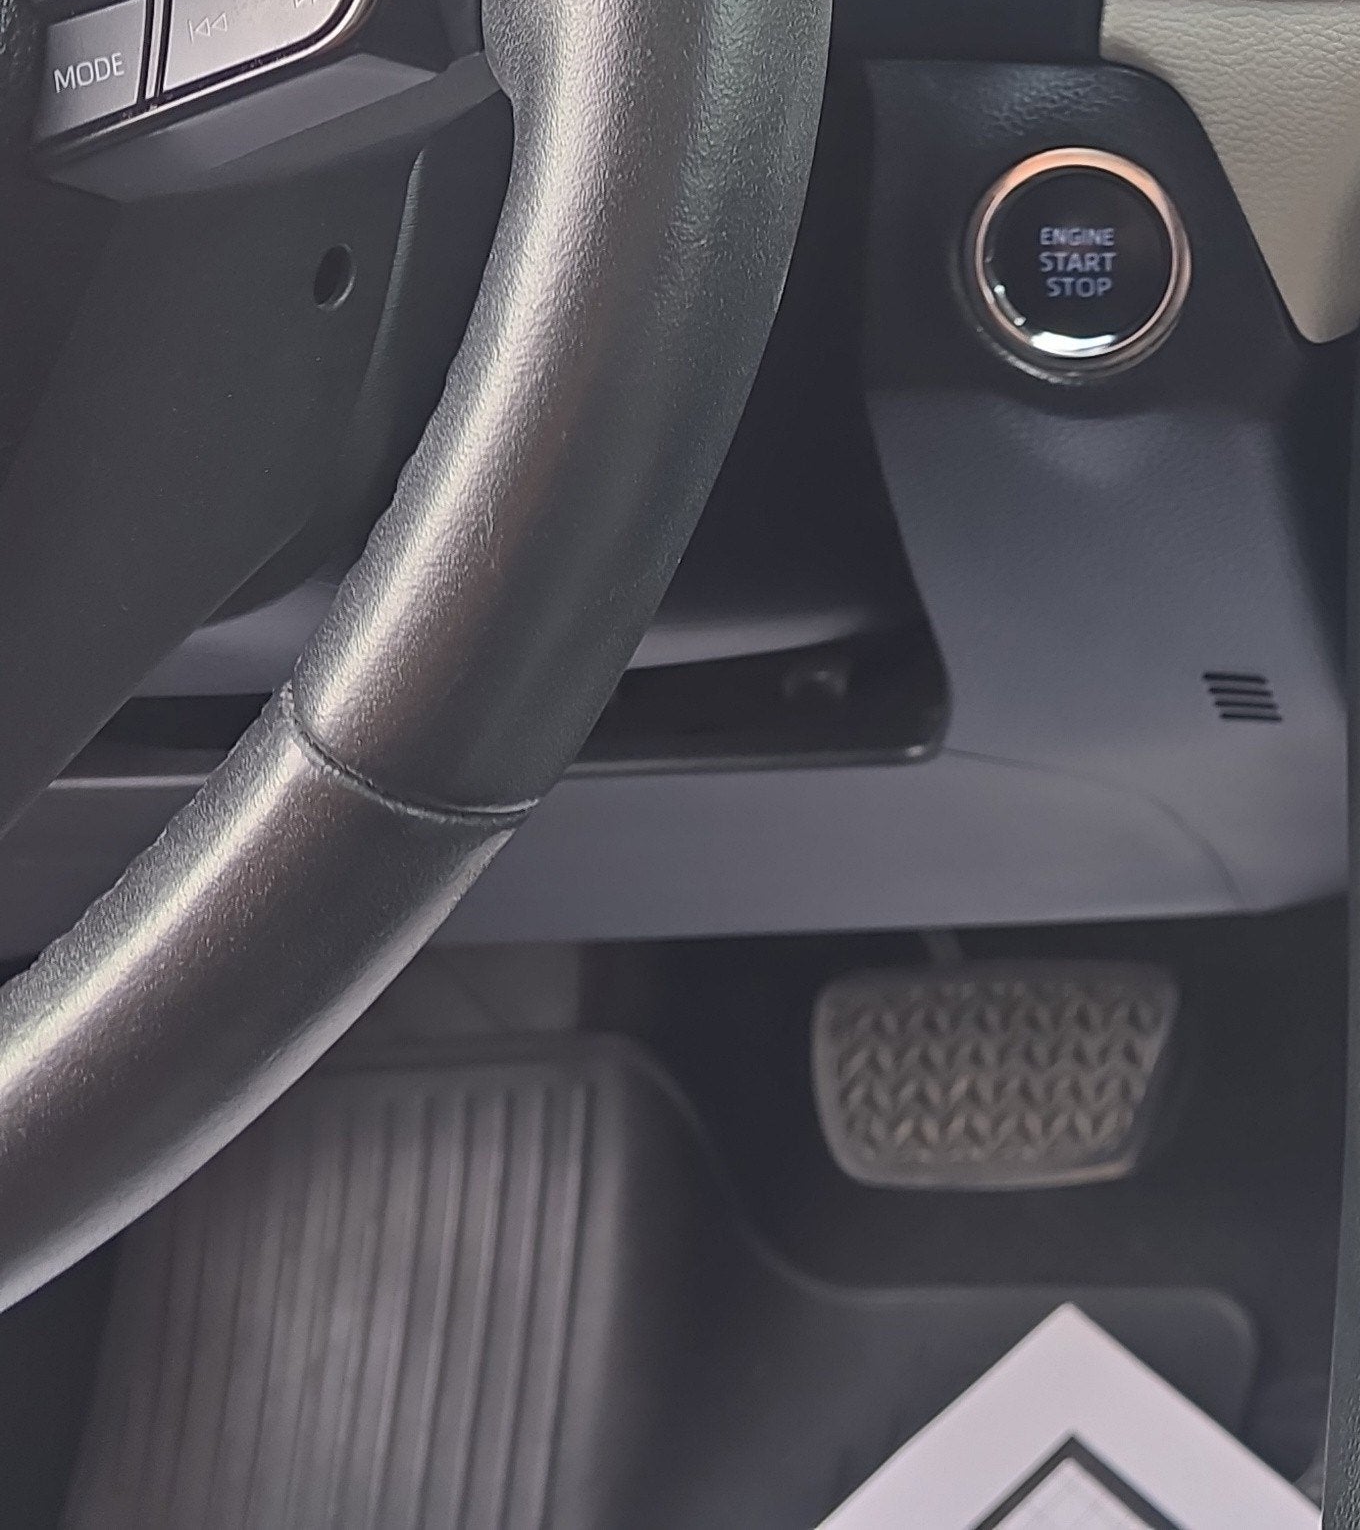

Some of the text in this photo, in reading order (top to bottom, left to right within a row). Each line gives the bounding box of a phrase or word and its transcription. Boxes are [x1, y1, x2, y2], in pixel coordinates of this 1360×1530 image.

[53, 53, 125, 94] MODE
[1040, 227, 1114, 247] ENGINE
[1039, 251, 1117, 272] START
[1046, 276, 1112, 298] STOP
